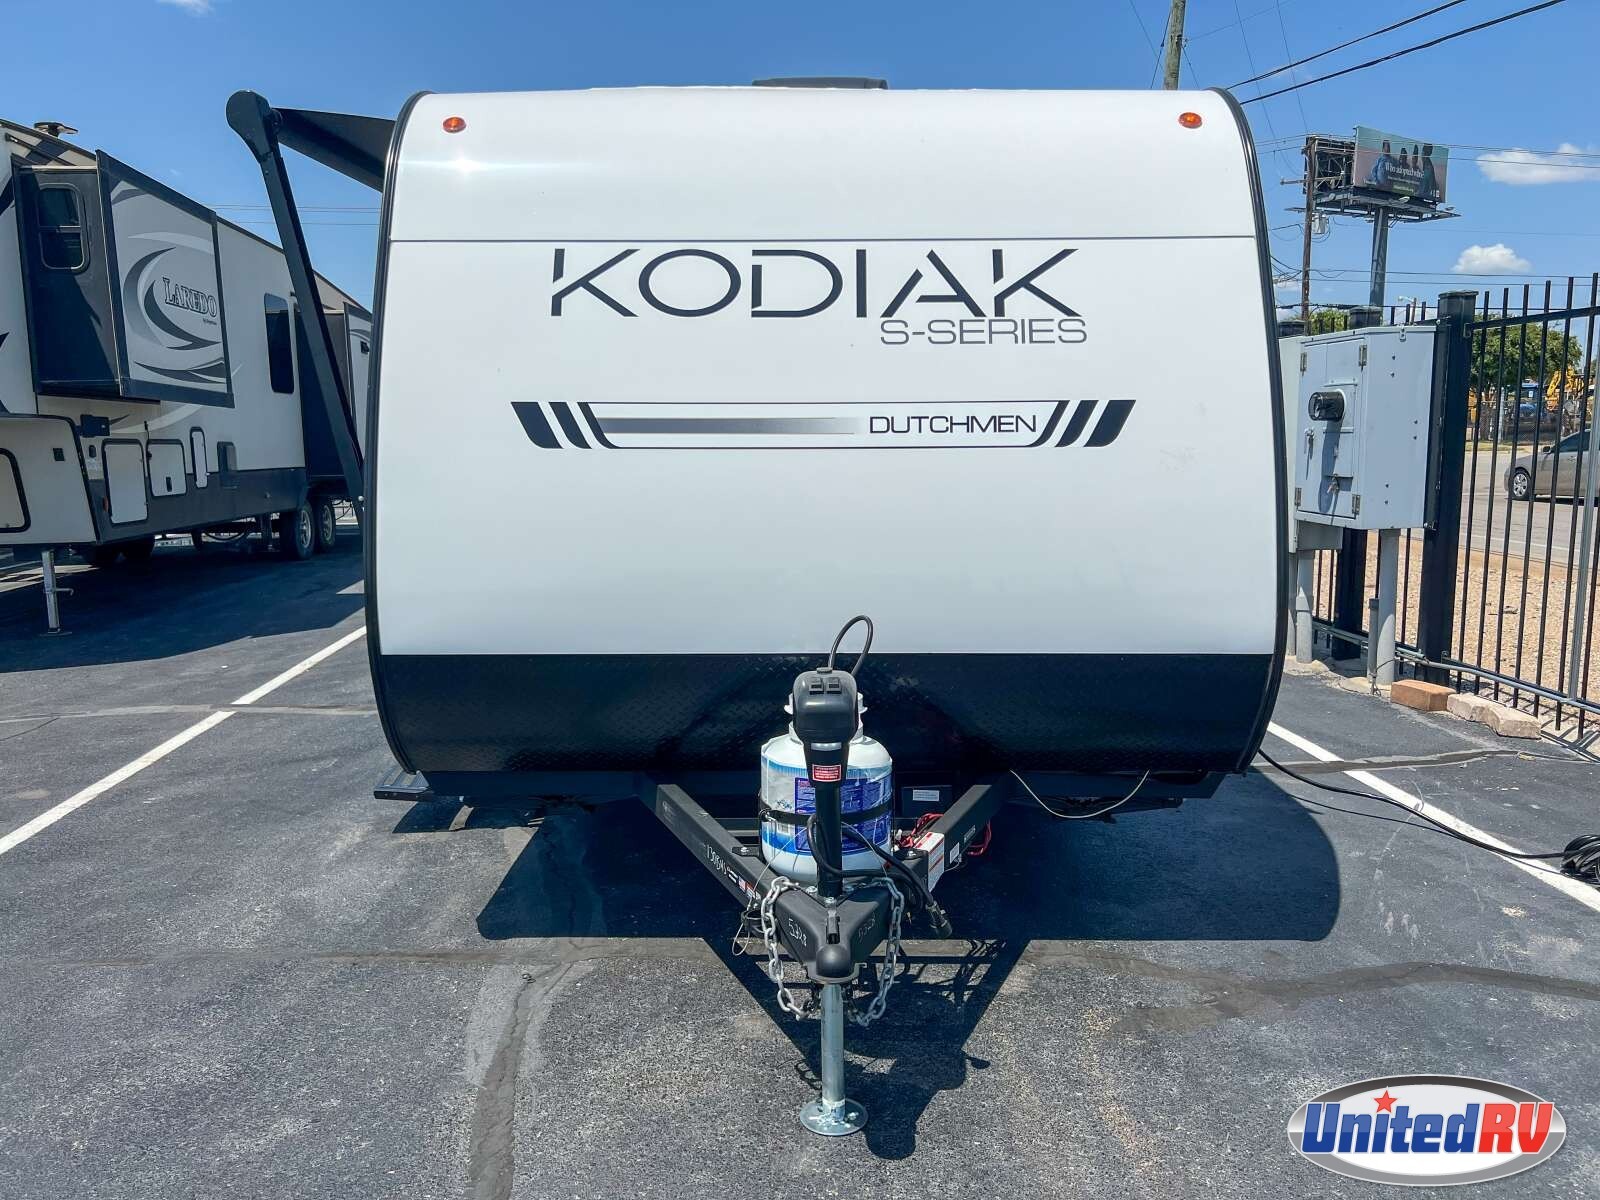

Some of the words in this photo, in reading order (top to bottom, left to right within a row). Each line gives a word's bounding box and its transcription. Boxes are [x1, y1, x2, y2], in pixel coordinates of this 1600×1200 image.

[162, 277, 218, 317] LAREDO
[551, 249, 1082, 317] KODIAK
[880, 319, 1087, 345] S-SERIES
[869, 415, 1037, 434] DUTCHMEN
